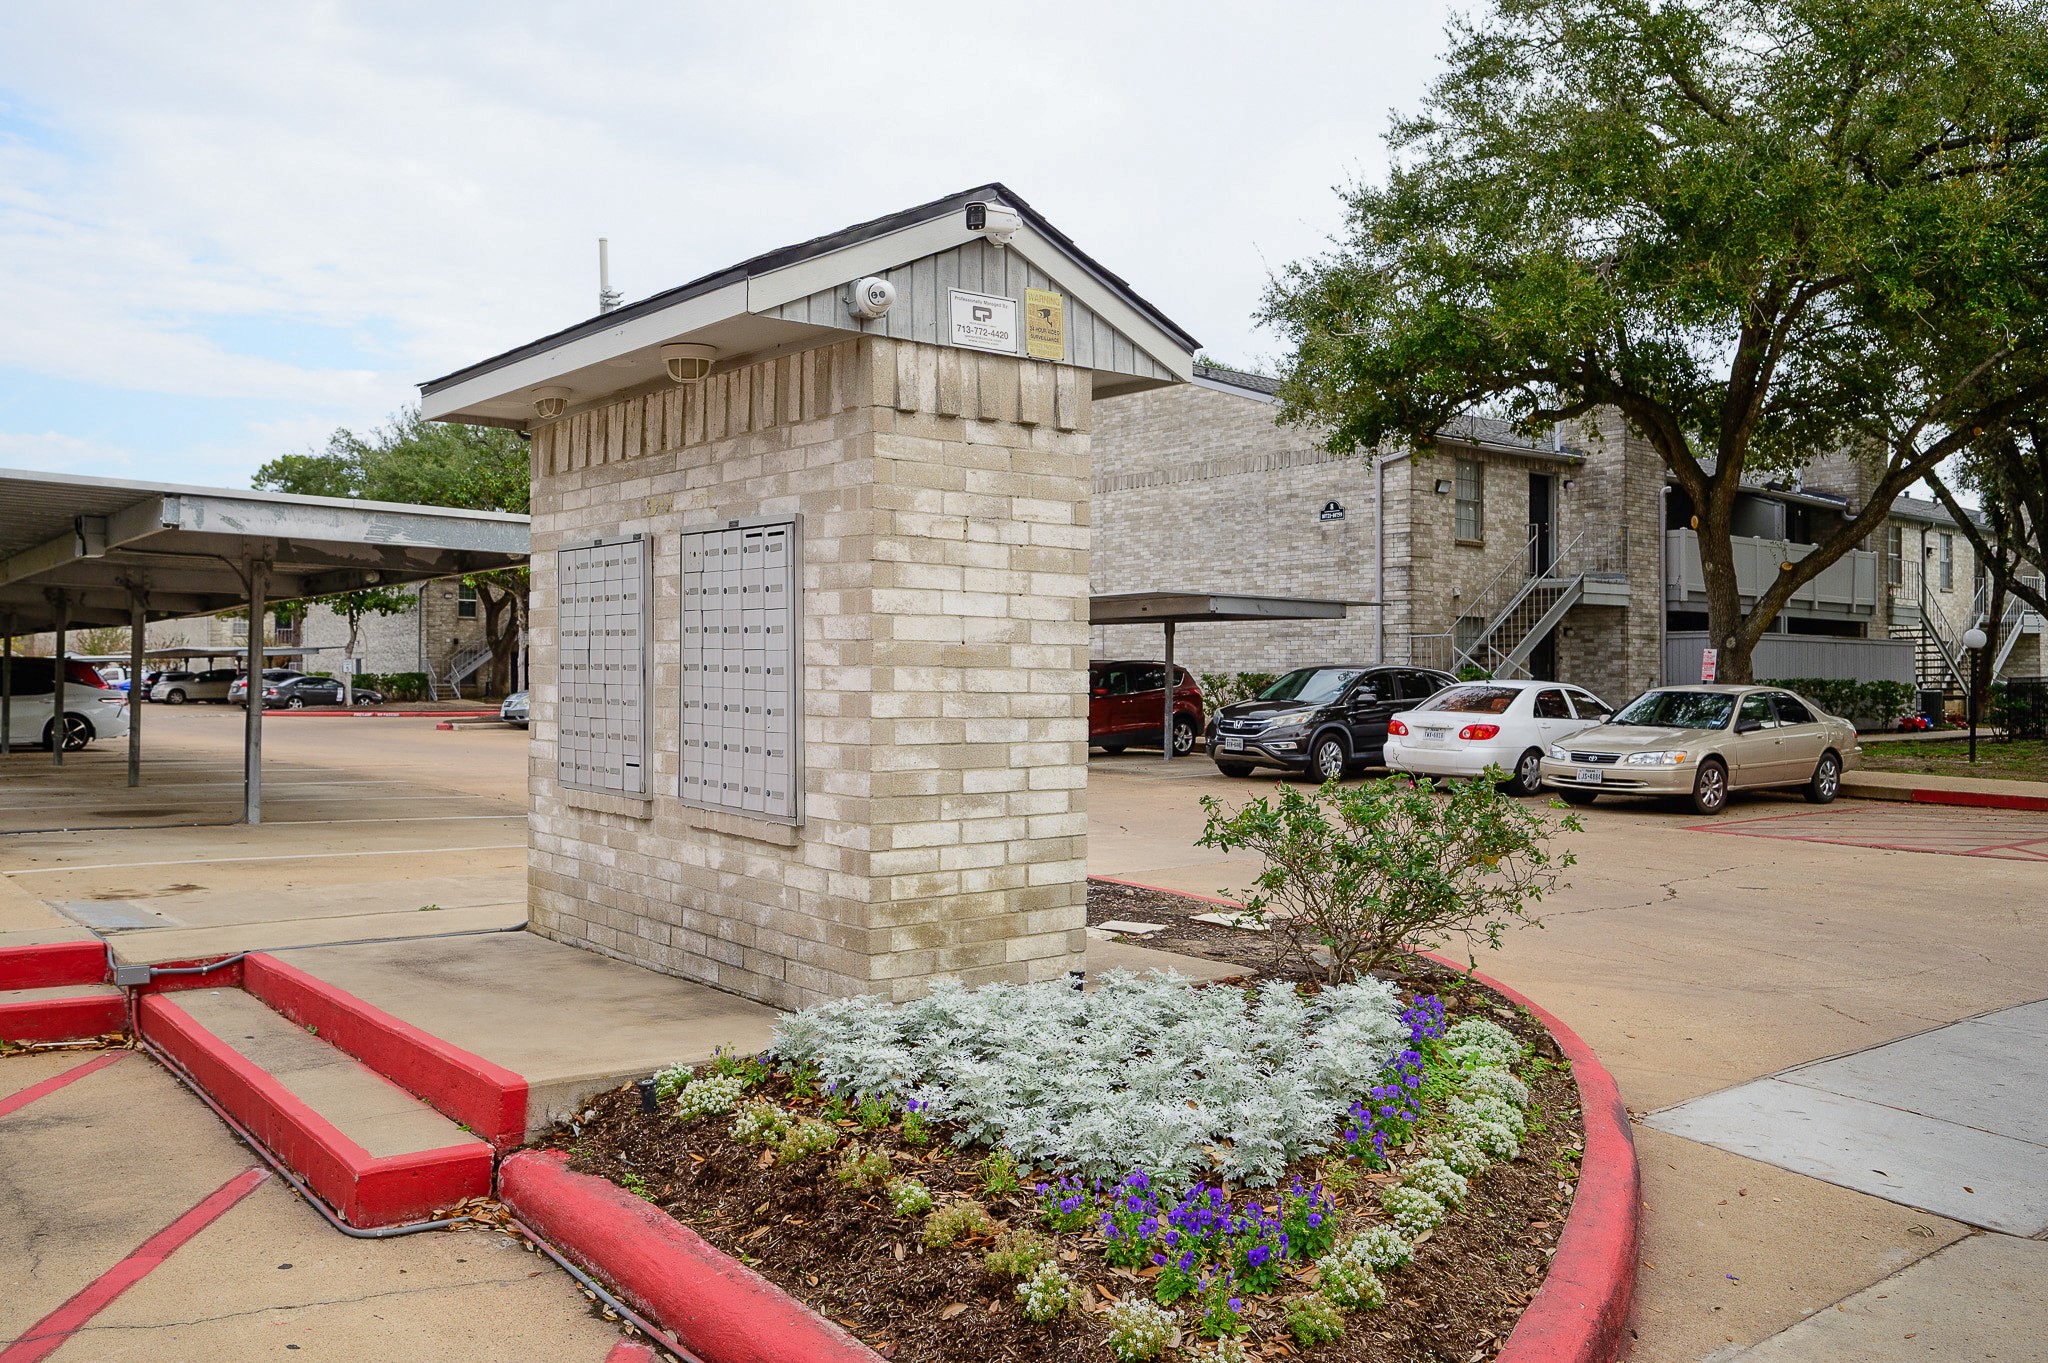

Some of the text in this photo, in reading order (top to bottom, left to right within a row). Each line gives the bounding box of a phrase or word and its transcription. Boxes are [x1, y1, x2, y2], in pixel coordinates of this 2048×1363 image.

[954, 295, 982, 305] Professionally
[984, 300, 1002, 308] Managed
[1028, 293, 1060, 306] WARNING
[957, 324, 1009, 340] 713-772-4420
